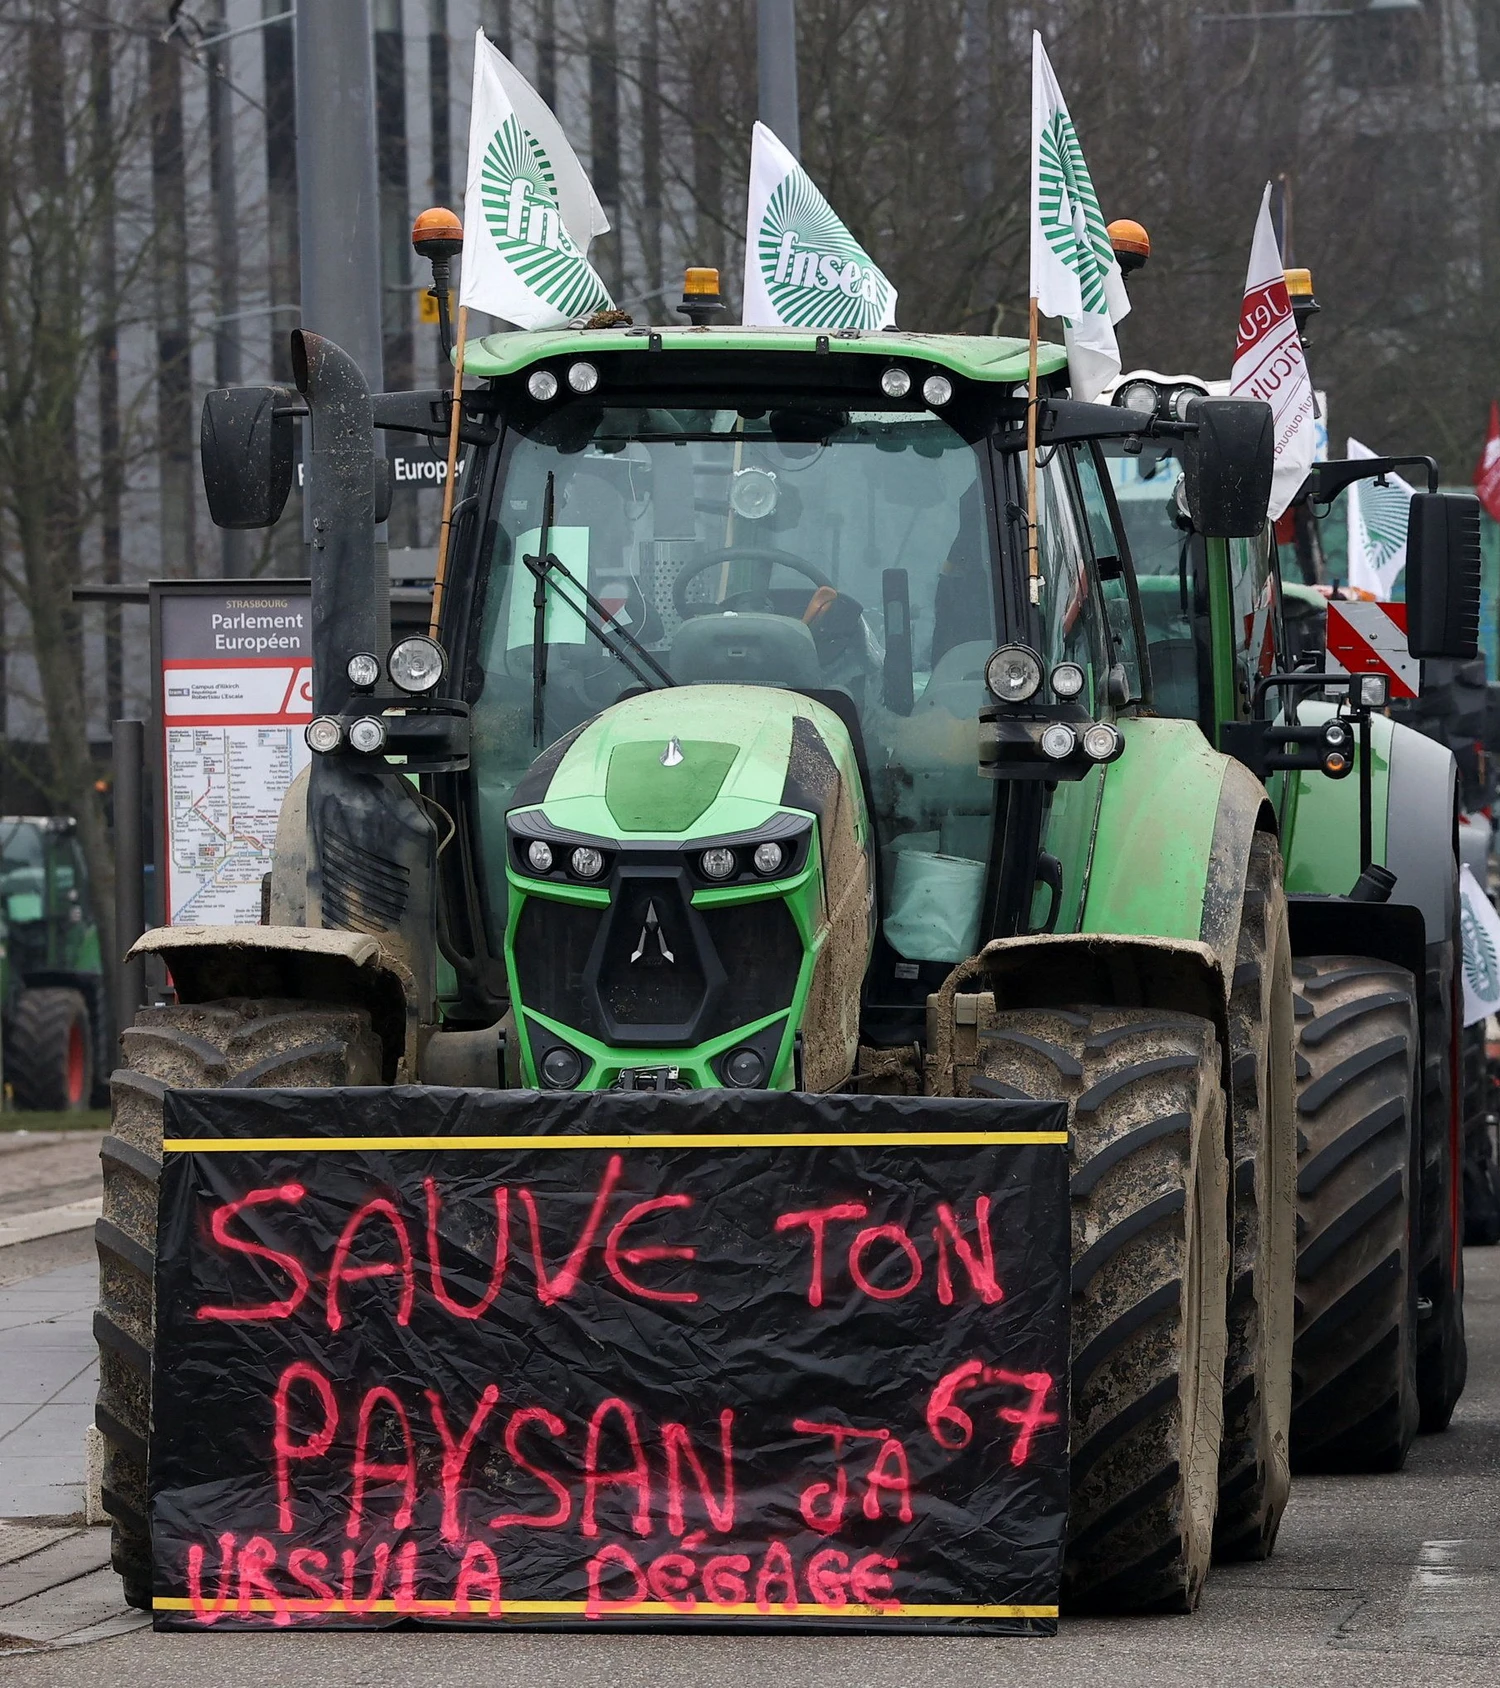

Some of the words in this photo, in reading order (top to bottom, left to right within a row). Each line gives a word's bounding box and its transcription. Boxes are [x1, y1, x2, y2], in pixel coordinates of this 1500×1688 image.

[773, 229, 879, 307] fnsea
[211, 613, 304, 630] Parlement
[215, 632, 300, 653] Européen
[226, 600, 288, 609] STRASBOURG
[198, 1154, 699, 1331] SAUVE
[775, 1194, 1004, 1308] TON
[272, 1361, 736, 1542] PAYSAN
[792, 1418, 914, 1534] JA
[924, 1358, 1059, 1466] 67
[187, 1532, 503, 1626] URSULA
[582, 1532, 904, 1619] DÉGAGE
